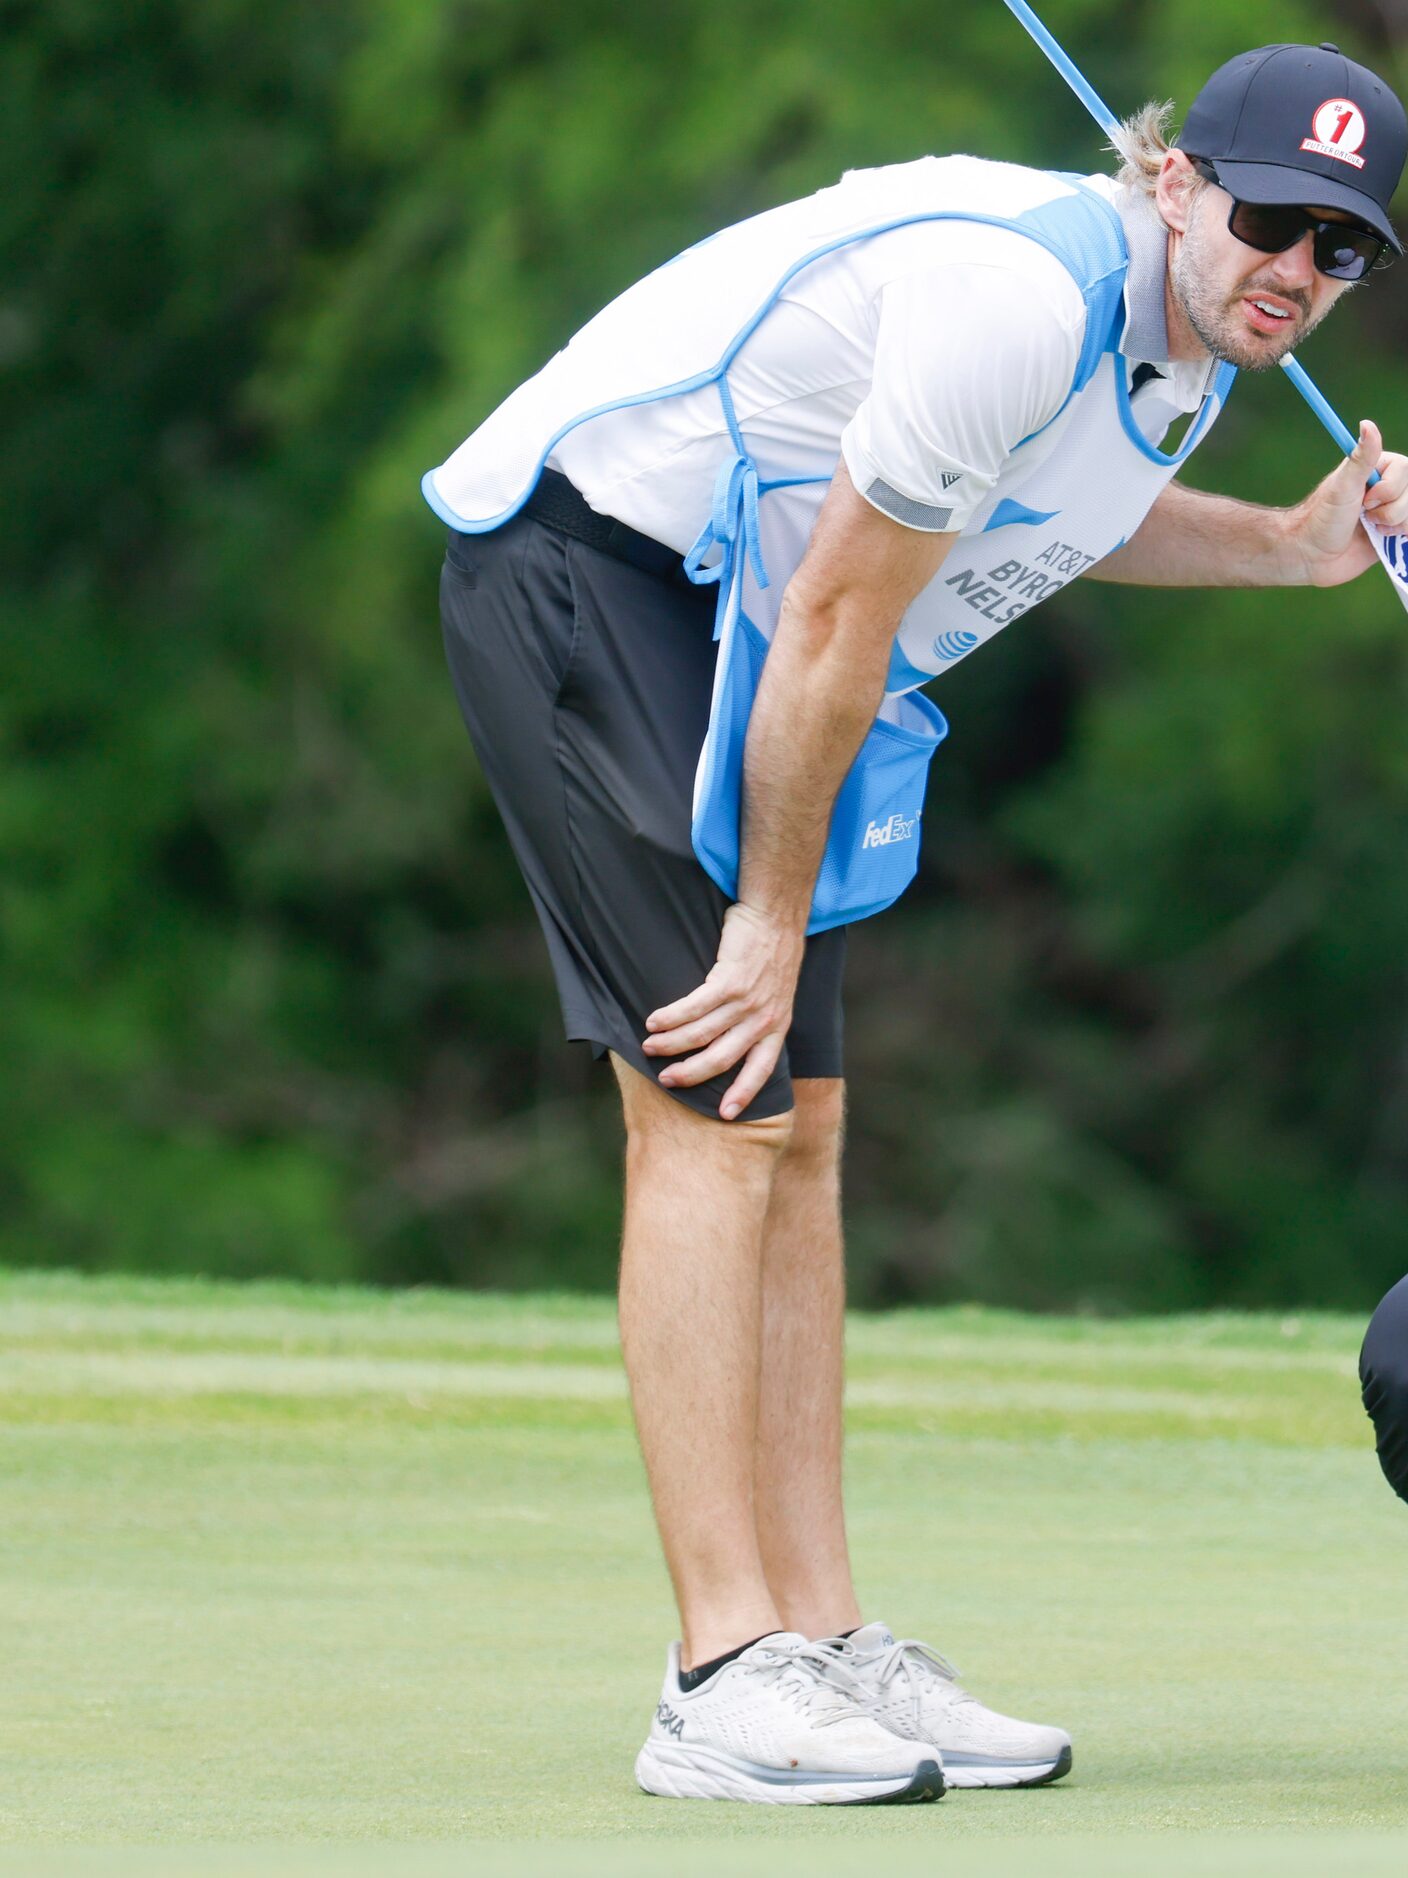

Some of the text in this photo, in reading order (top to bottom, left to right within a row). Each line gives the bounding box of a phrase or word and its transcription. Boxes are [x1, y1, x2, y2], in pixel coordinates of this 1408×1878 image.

[1034, 541, 1096, 576] AT&T
[945, 569, 1026, 624] NELS
[987, 559, 1064, 601] BYRO
[862, 813, 915, 849] FedEx
